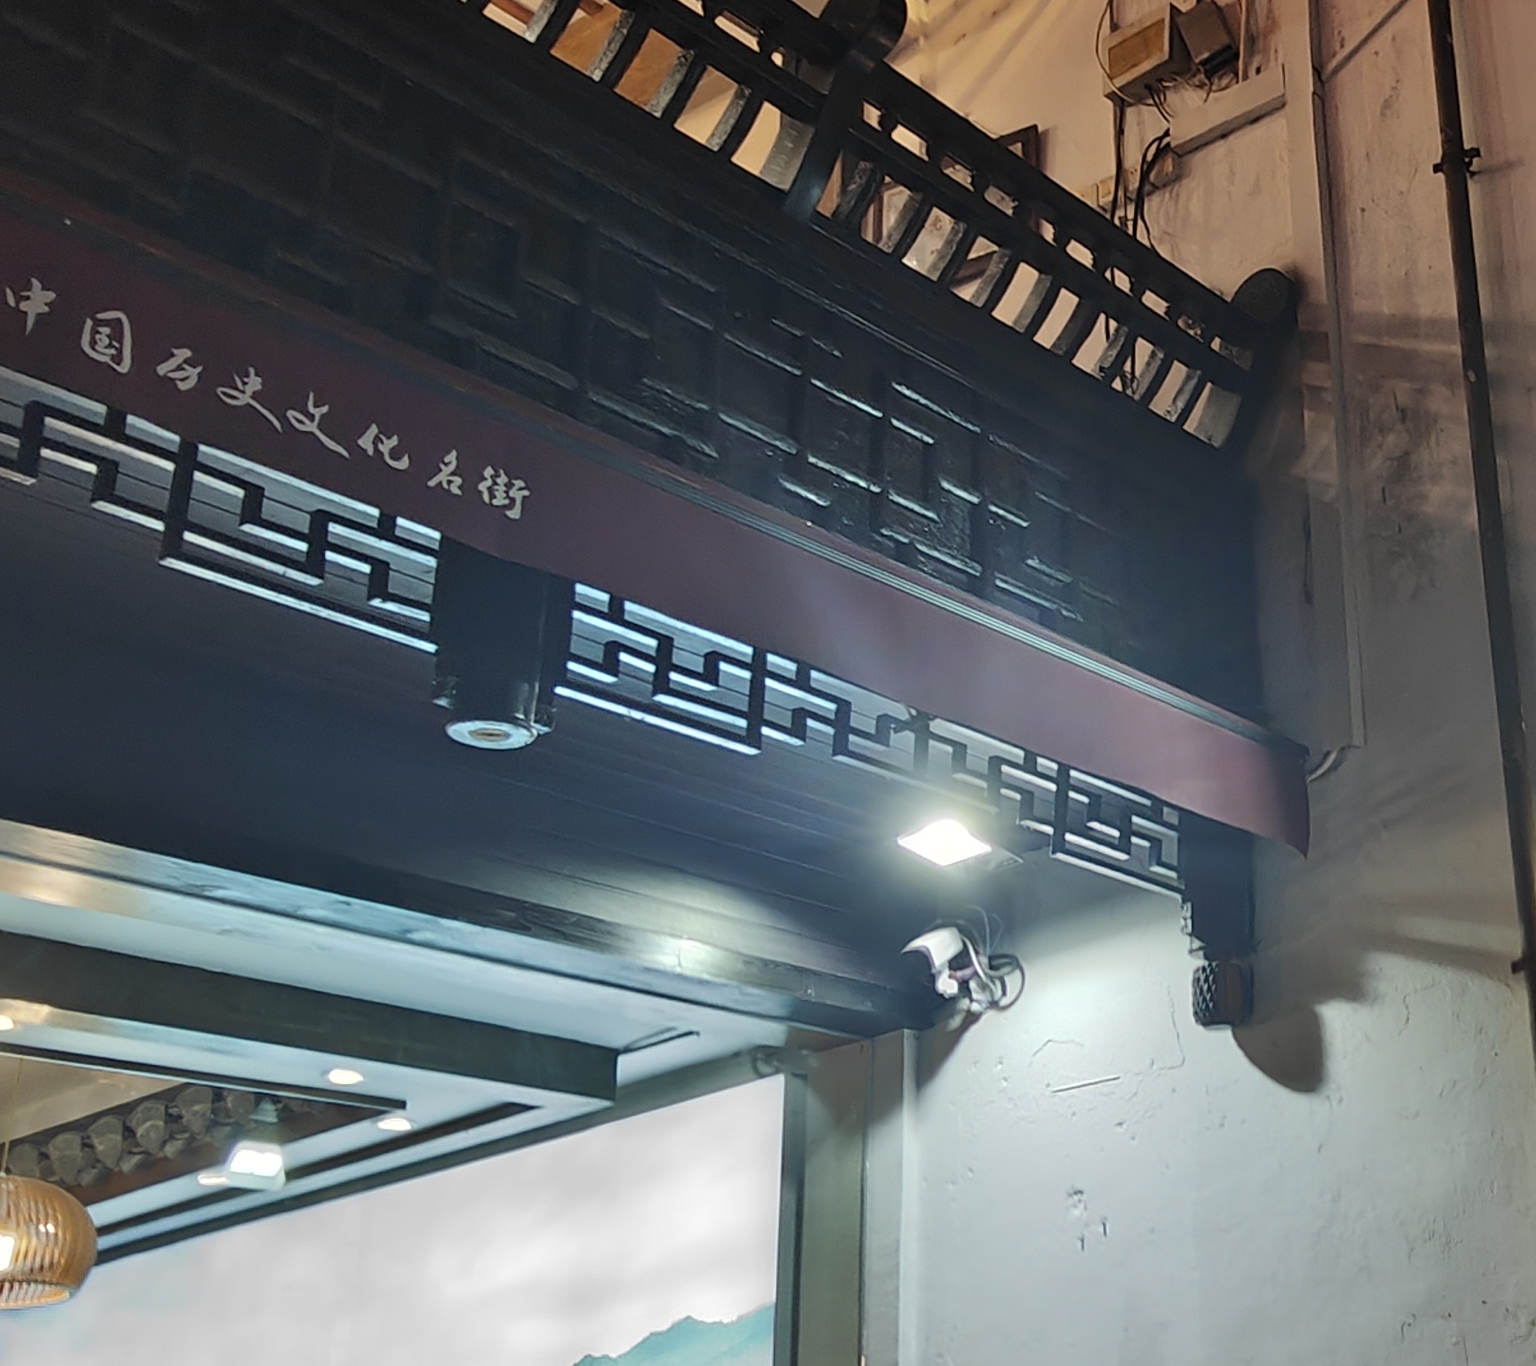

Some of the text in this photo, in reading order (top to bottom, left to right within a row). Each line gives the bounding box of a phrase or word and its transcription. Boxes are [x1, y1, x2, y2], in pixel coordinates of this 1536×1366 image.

[5, 277, 531, 520] 中国历史文化名街
